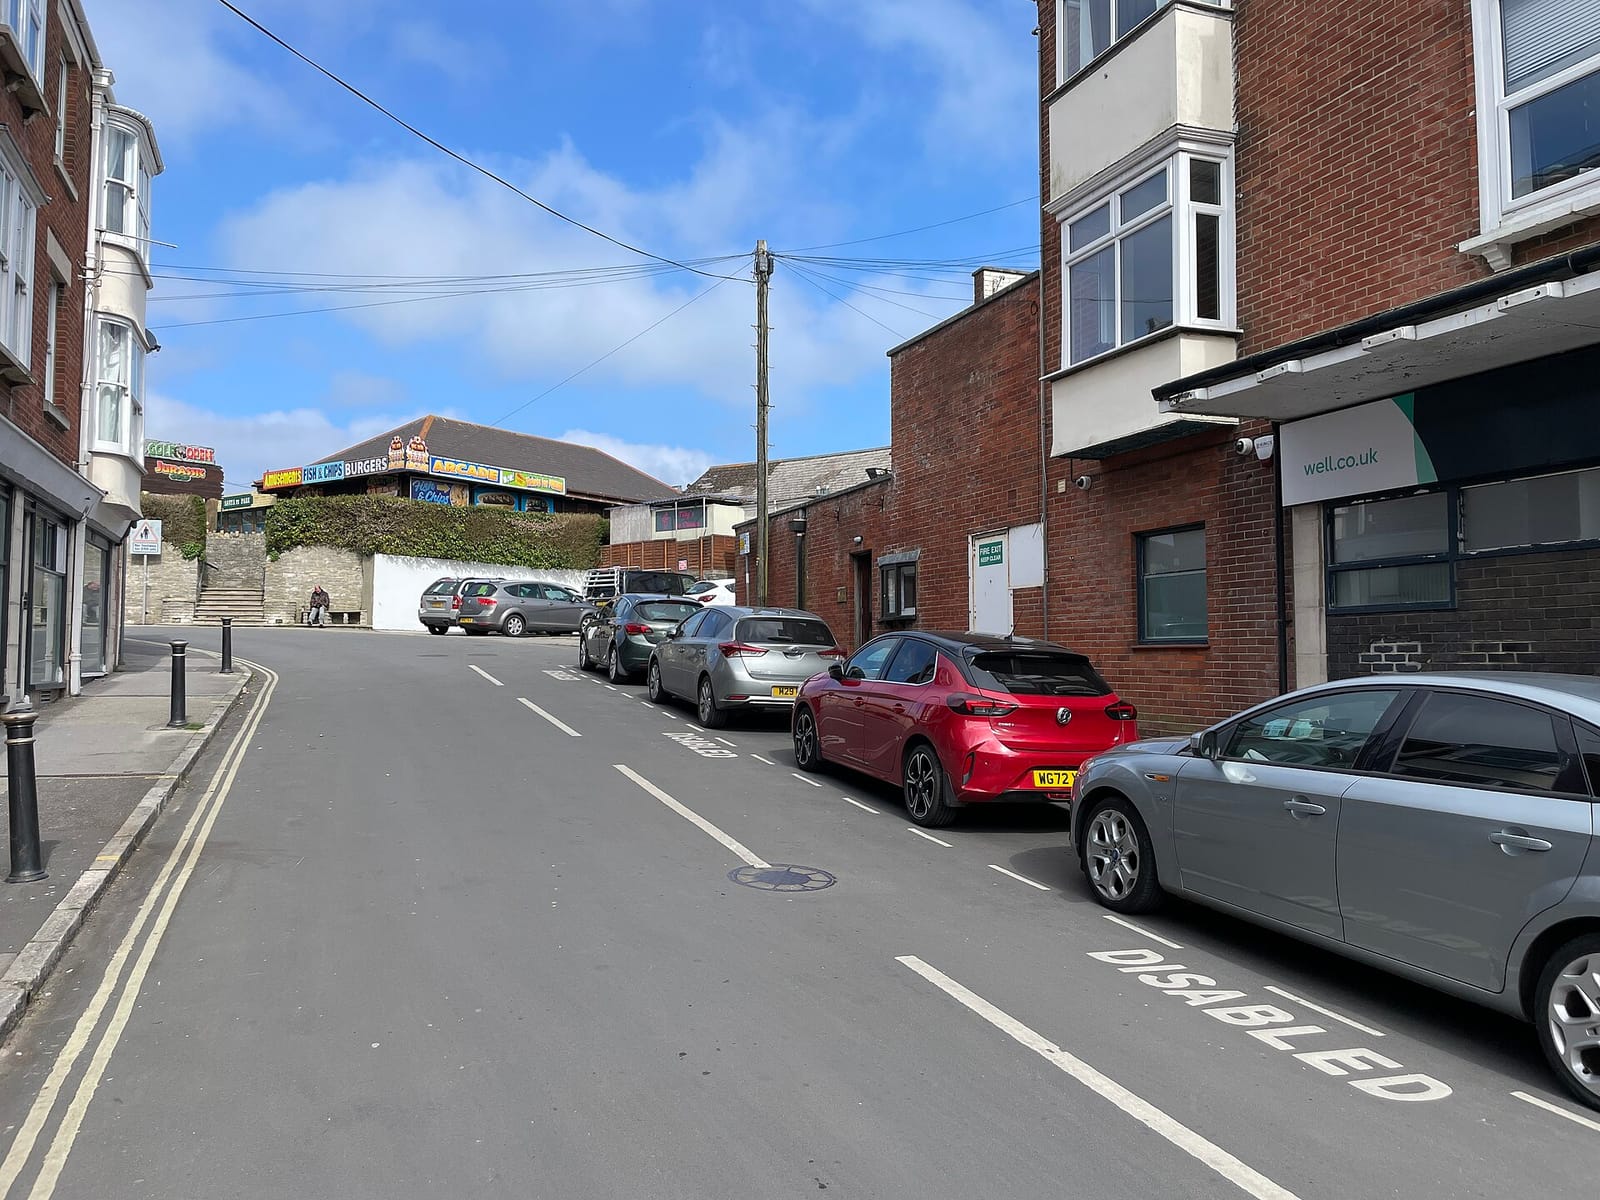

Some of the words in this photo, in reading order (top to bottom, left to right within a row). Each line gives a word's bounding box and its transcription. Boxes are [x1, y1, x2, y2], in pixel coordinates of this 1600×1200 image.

[148, 442, 175, 458] GOLF
[186, 446, 215, 462] OPEN
[345, 457, 388, 475] BURGERS
[433, 459, 498, 480] ARCADE
[1303, 447, 1378, 476] well.co.uk
[304, 467, 316, 481] FISH
[323, 463, 342, 478] CHIPS
[980, 547, 990, 556] FIRE
[991, 545, 1001, 553] EXIT
[1038, 772, 1069, 785] WG72
[1085, 948, 1453, 1101] DISABLED
